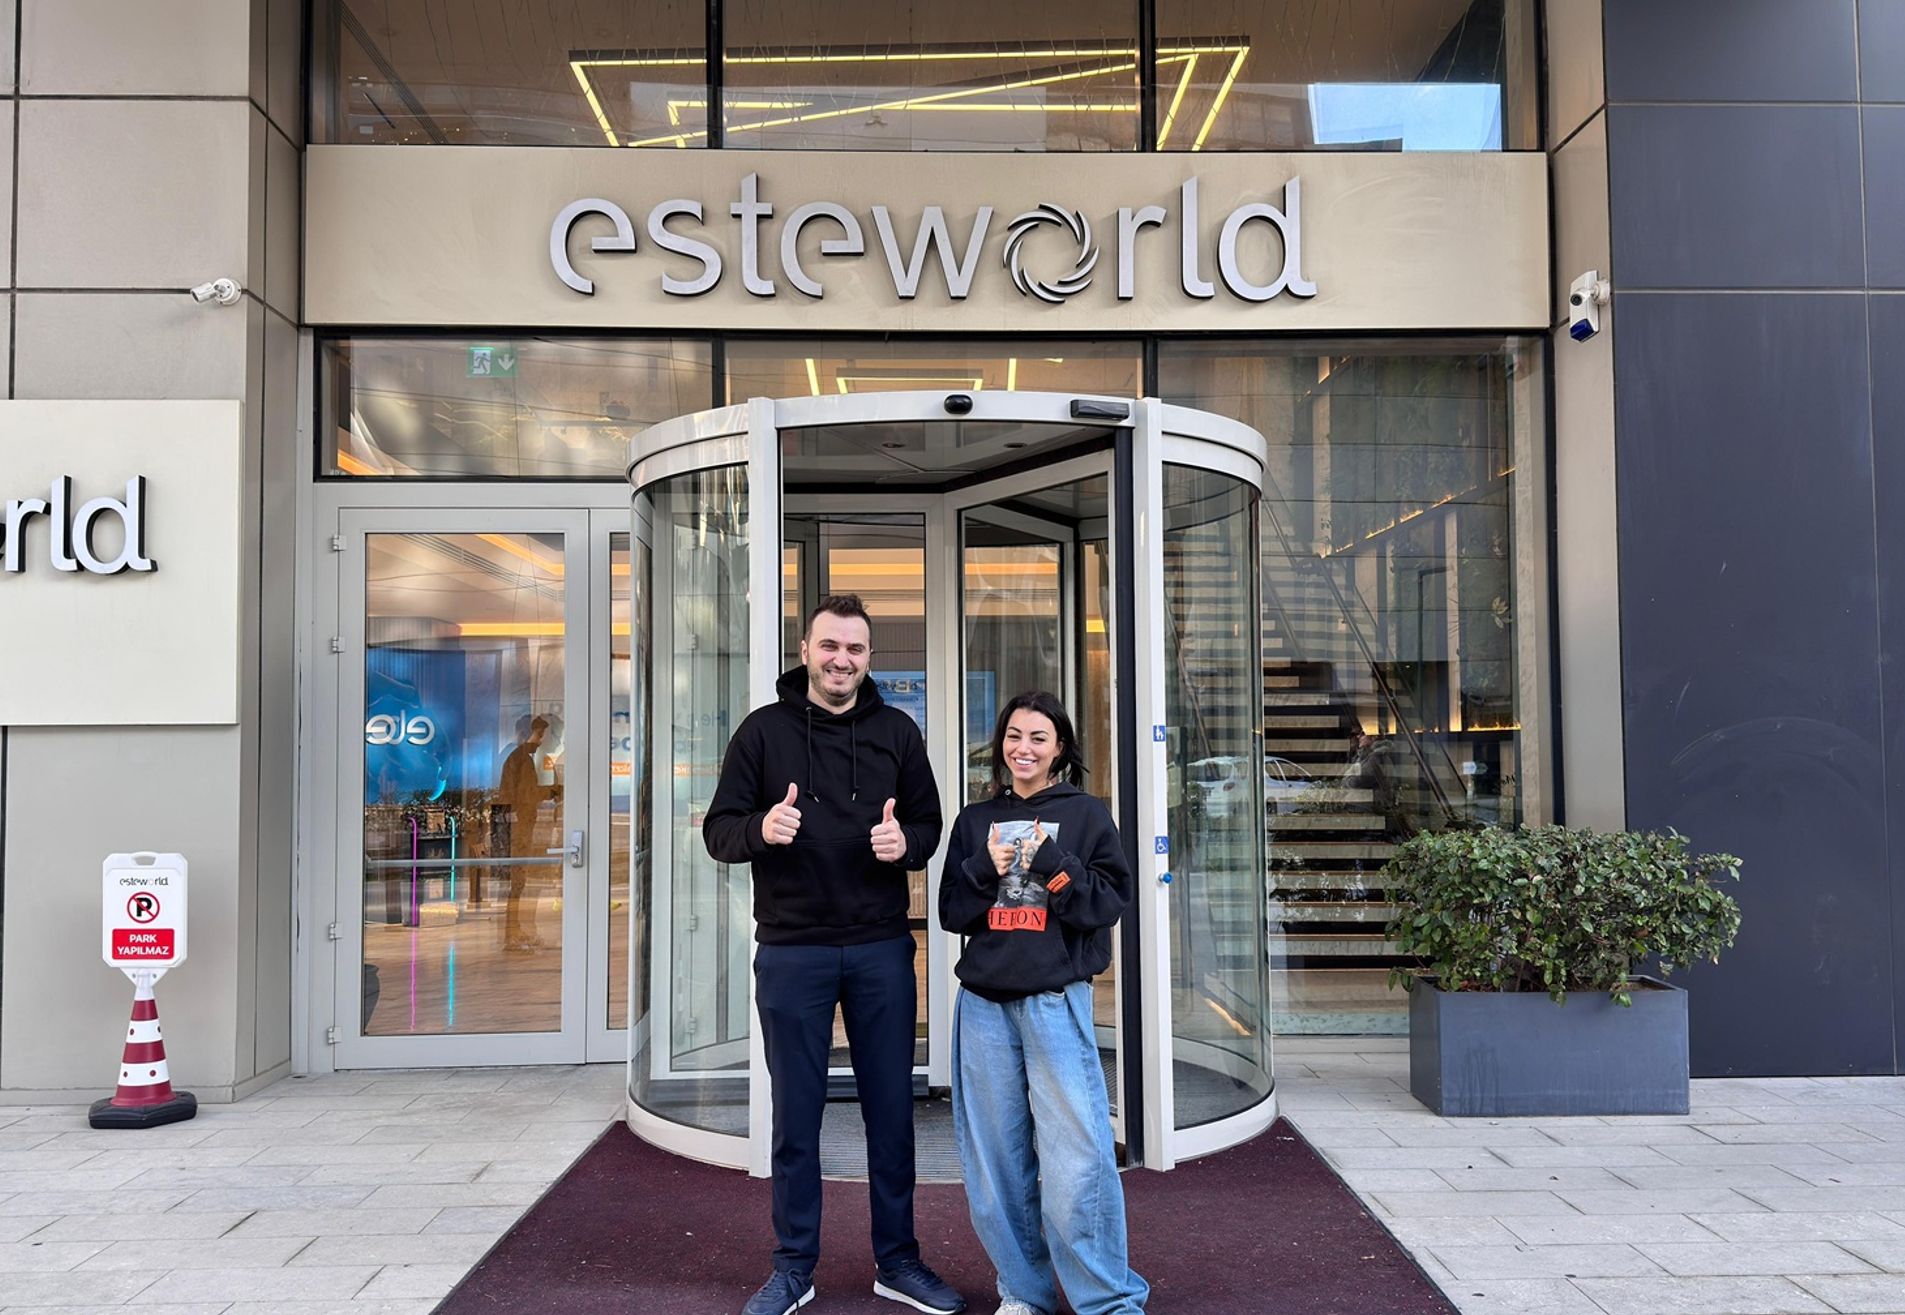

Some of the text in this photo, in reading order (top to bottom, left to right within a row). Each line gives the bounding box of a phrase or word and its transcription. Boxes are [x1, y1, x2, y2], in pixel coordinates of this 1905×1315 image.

[0, 474, 158, 576] rld
[129, 934, 157, 943] PARK
[117, 946, 169, 955] YAPILMAZ
